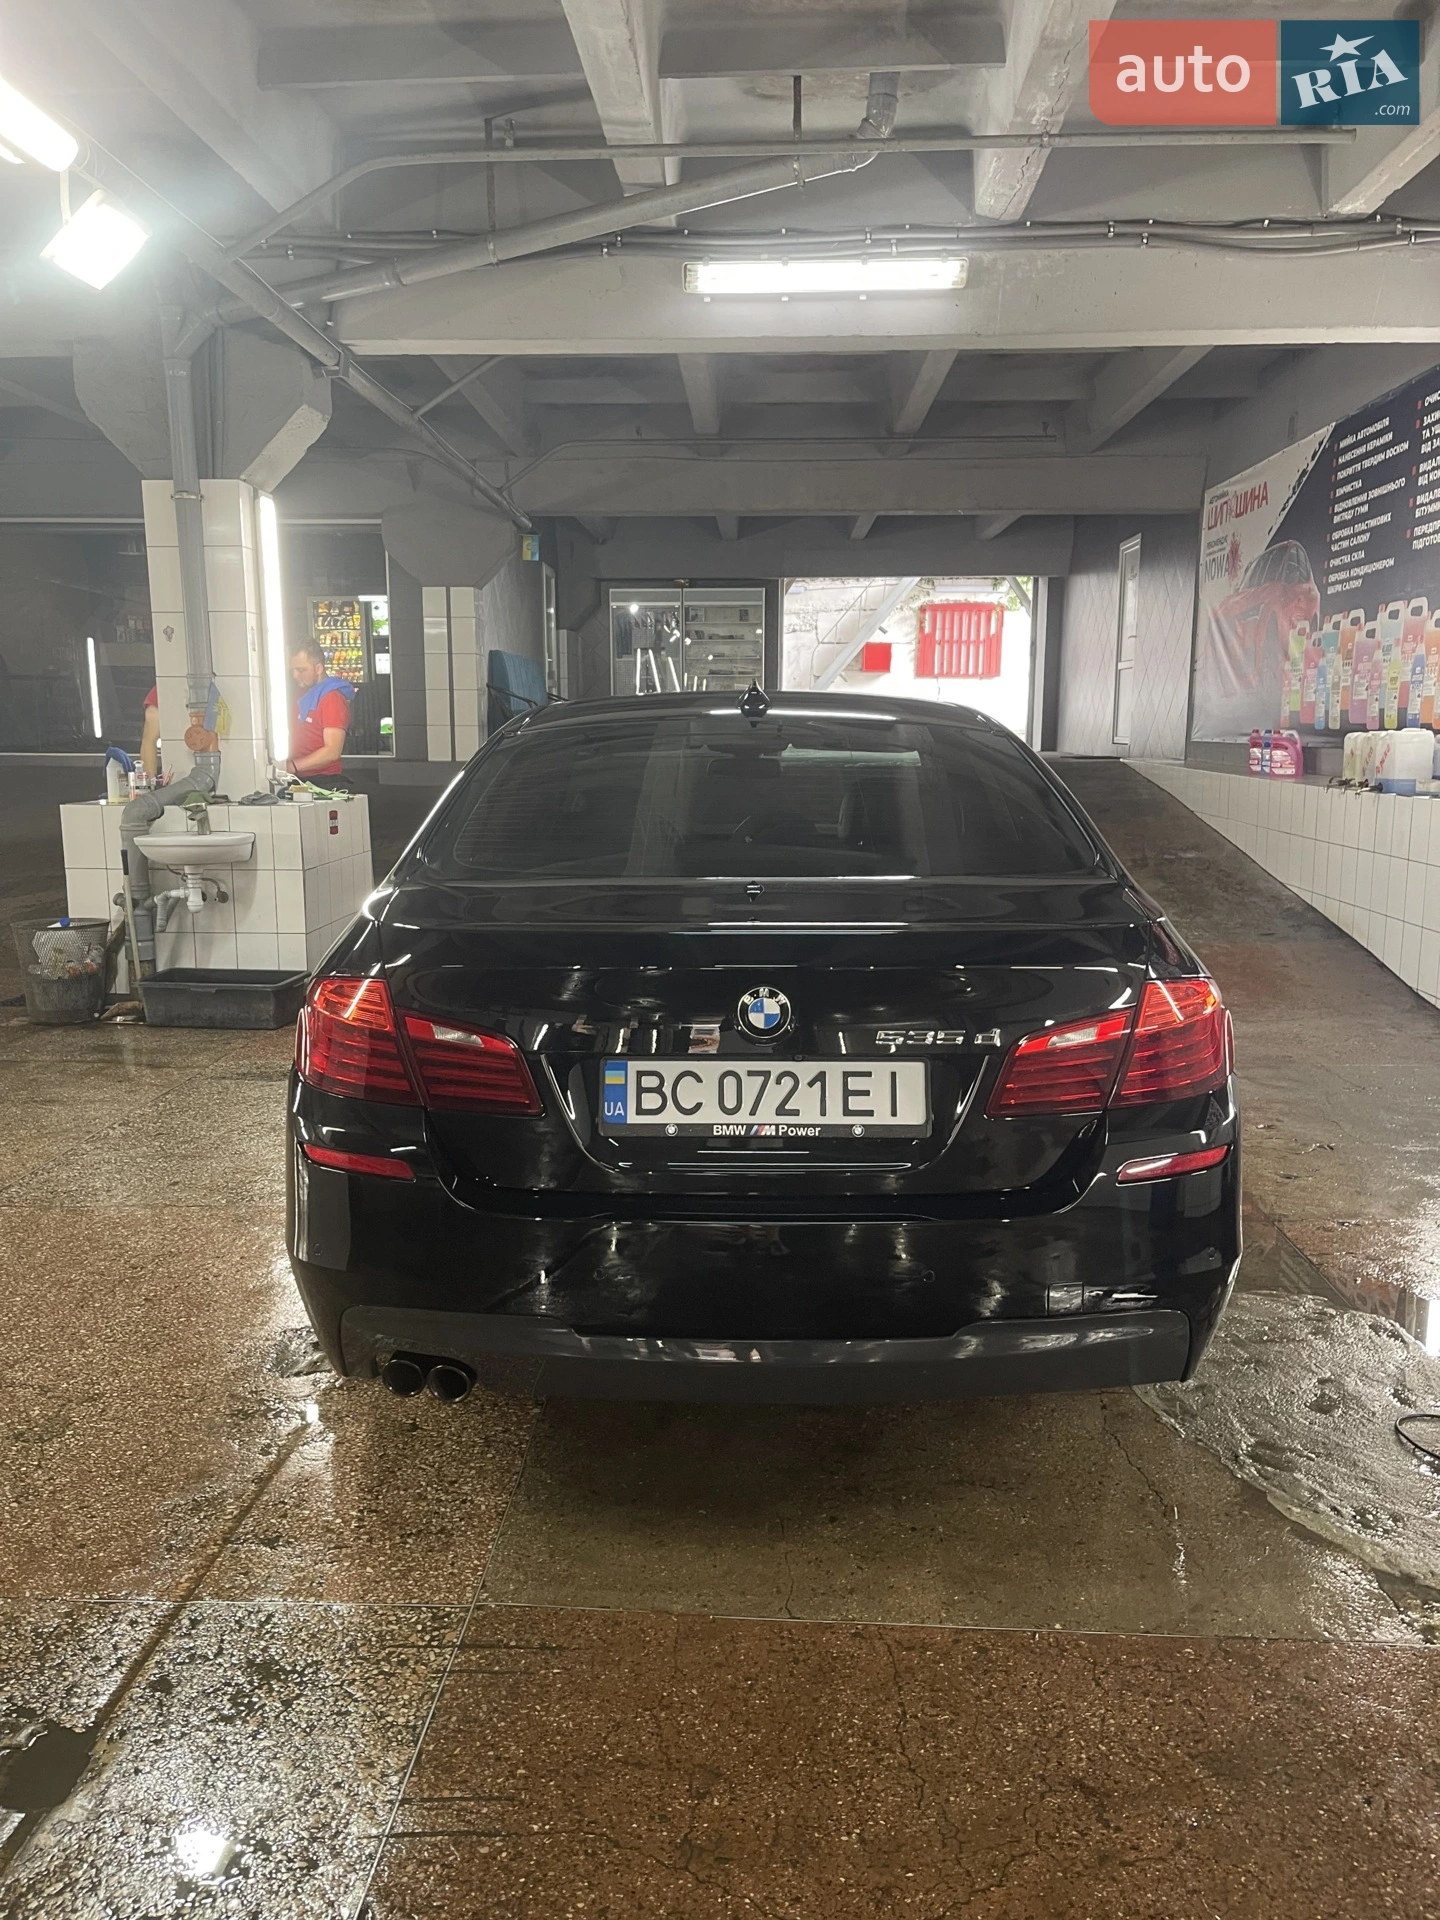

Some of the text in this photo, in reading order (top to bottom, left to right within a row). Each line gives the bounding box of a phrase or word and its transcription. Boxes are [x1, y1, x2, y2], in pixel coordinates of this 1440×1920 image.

[1339, 417, 1390, 449] МИЙКА АВТОМОБІЛЯ
[1422, 428, 1430, 440] ТА
[1338, 432, 1393, 465] НАНЕСЕННЯ КЕРАМІКИ
[1421, 440, 1431, 454] ВІД
[1336, 441, 1409, 481] ПОКРИТТЯ ТВЕРДИМ ВОСКОМ
[1335, 479, 1362, 497] ХІМЧИСТКА
[1418, 473, 1428, 486] ВІД
[1235, 481, 1268, 519] ШИНА
[1334, 477, 1405, 513] ВІДНОВЛЕННЯ ЗОВНІШНЬОГО
[1355, 503, 1369, 516] ГУМИ
[1331, 512, 1392, 541] ОБРОБКА ПЛАСТИКОВИХ
[1331, 532, 1371, 552] ЧАСТИН САЛОНУ
[1329, 549, 1365, 568] ОЧИСТКА СКЛА
[1328, 570, 1349, 583] ОБРОБКА
[1342, 577, 1363, 591] САЛОНУ
[743, 988, 787, 1006] BMW
[604, 1101, 625, 1116] UA
[713, 1125, 746, 1136] BMW
[778, 1125, 821, 1137] Power
